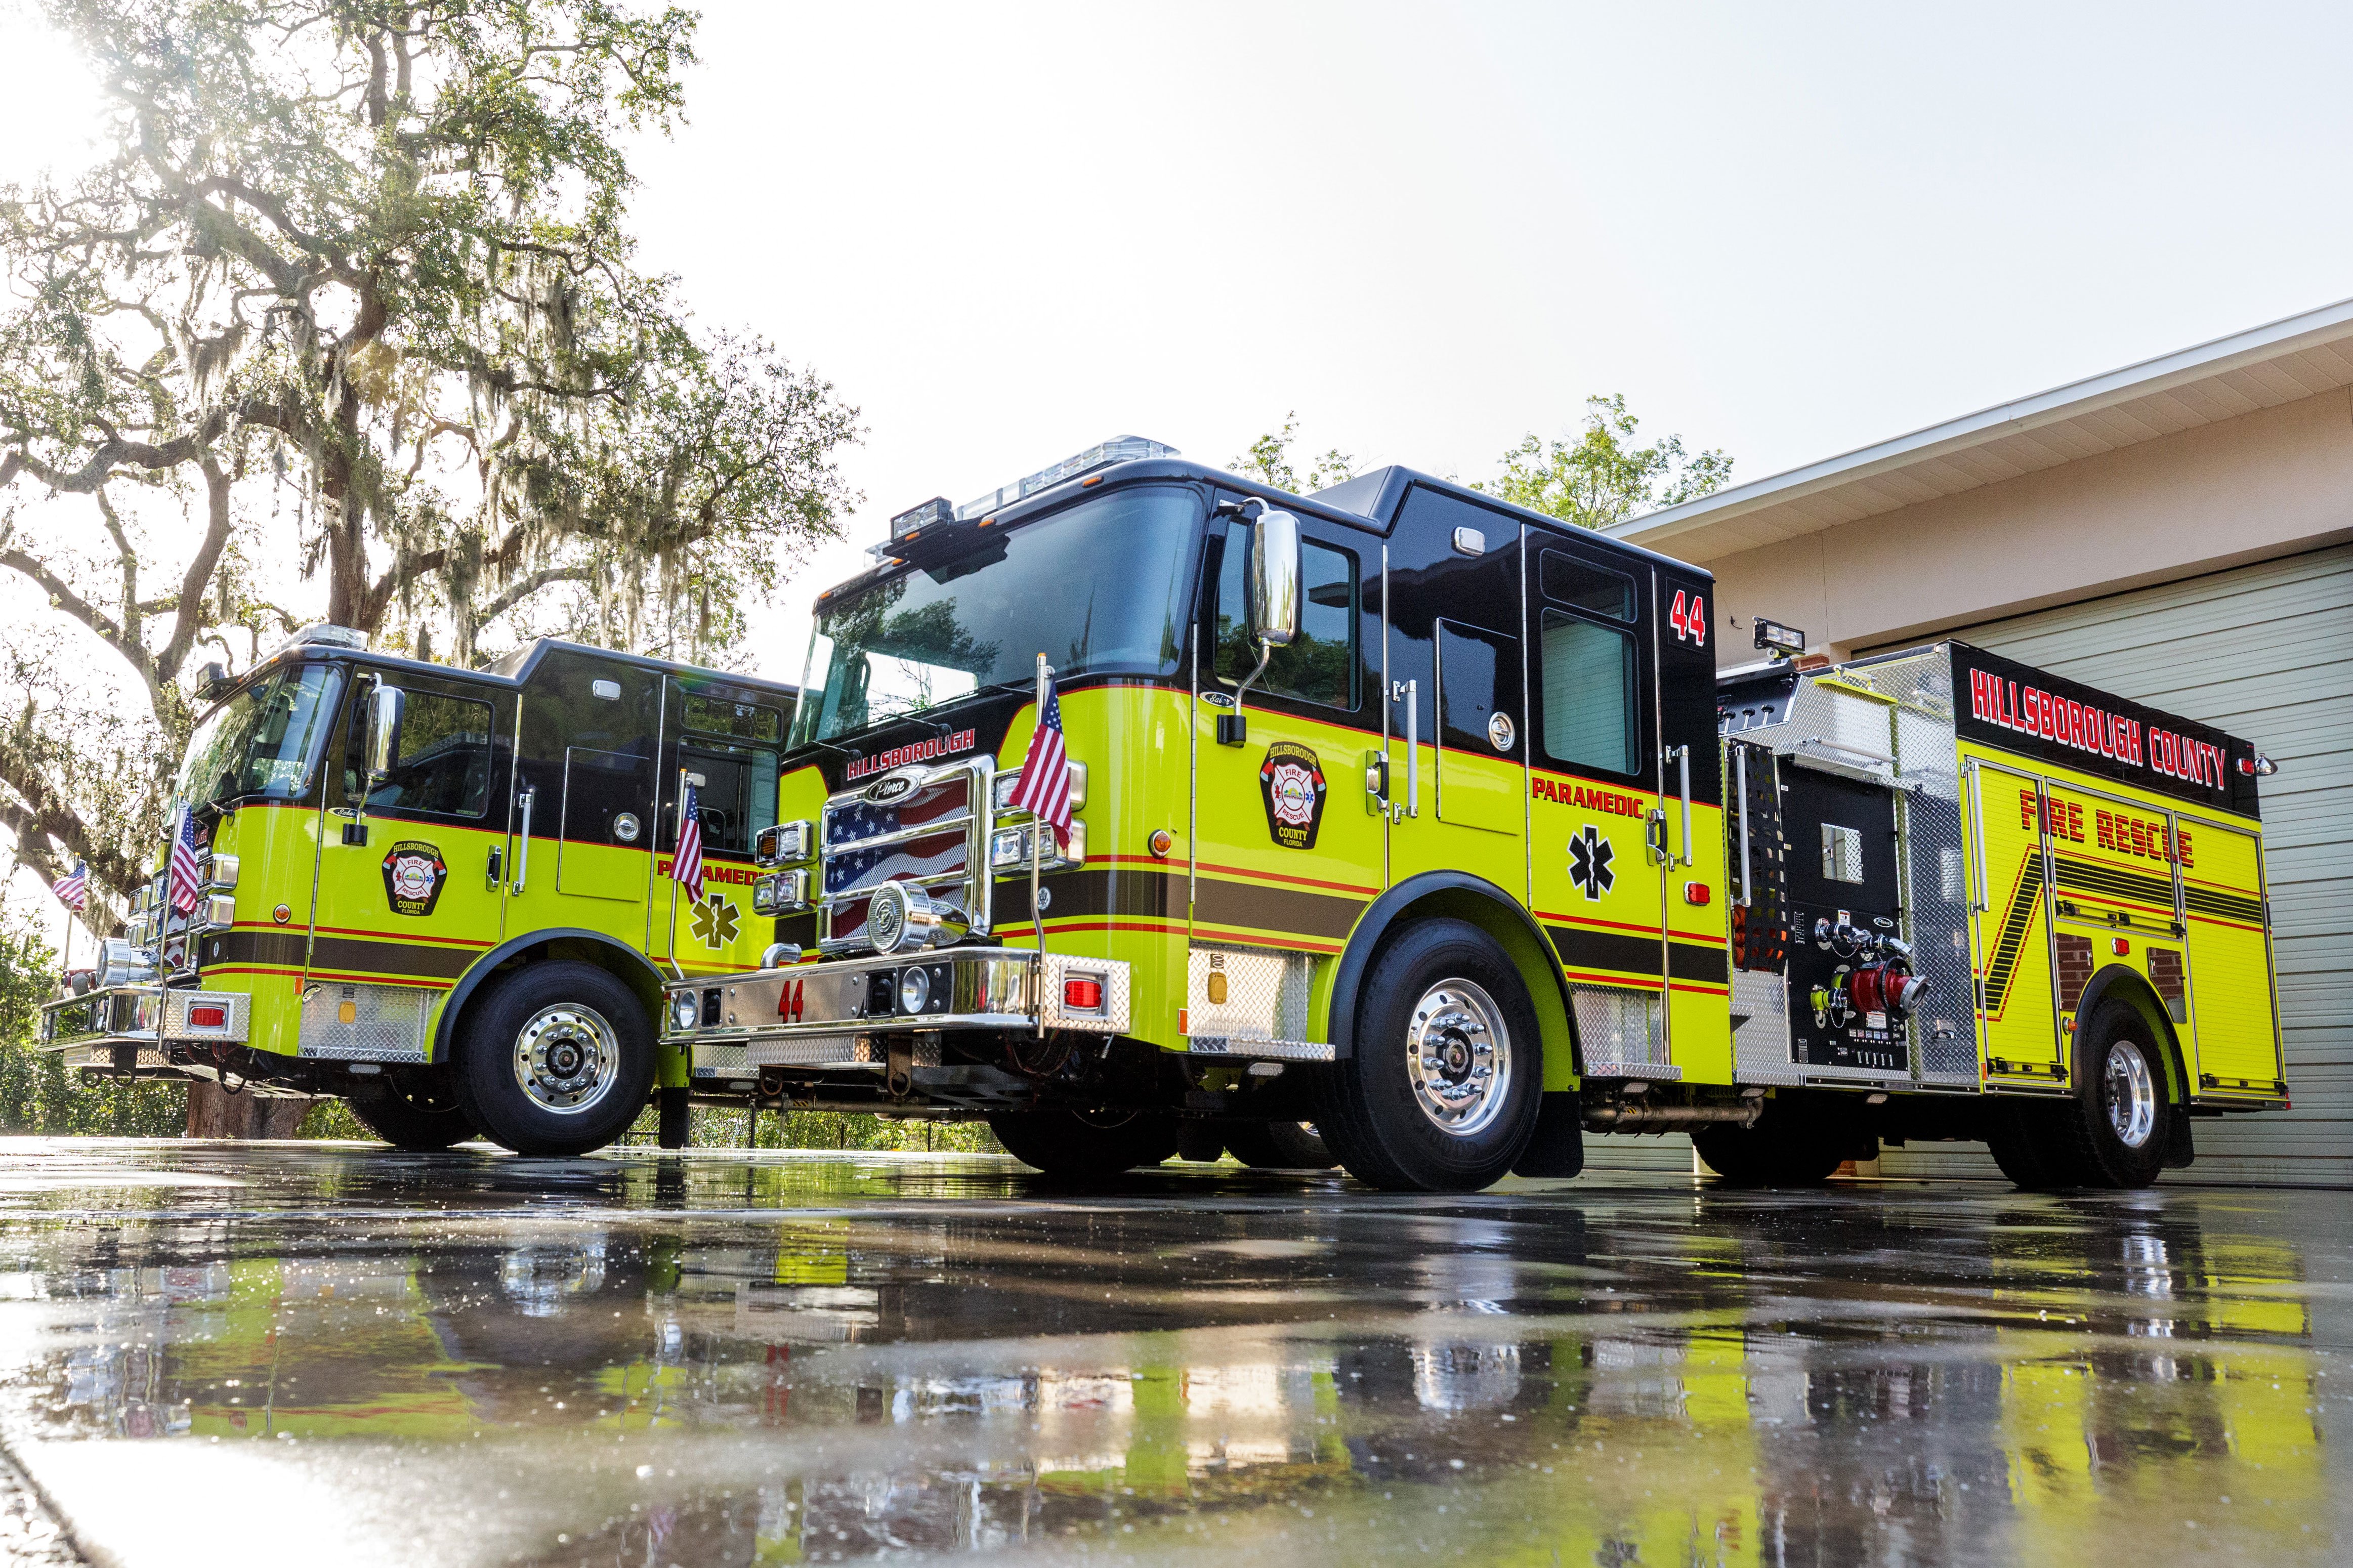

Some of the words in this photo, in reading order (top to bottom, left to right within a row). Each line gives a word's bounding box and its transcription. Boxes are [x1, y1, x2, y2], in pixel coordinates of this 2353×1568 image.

[1670, 589, 1705, 647] 44
[1970, 668, 2143, 768] HILLSBOROUGH
[2149, 727, 2225, 790] COUNTY
[847, 729, 975, 781] HILLSBOROUGH
[1270, 745, 1317, 766] HILLSBOROUGH
[1285, 769, 1301, 778] FIRE
[875, 780, 905, 799] Pierce
[1532, 777, 1644, 819] PARAMEDIC
[1282, 809, 1304, 820] RESCUE
[1279, 827, 1307, 840] COUNTY
[2020, 789, 2085, 843] FIRE
[2096, 809, 2194, 868] RESCUE
[393, 843, 439, 858] HILLSBOROUGH
[1284, 839, 1302, 847] FLORIDA
[398, 901, 426, 910] COUNTY
[778, 980, 804, 1024] 44
